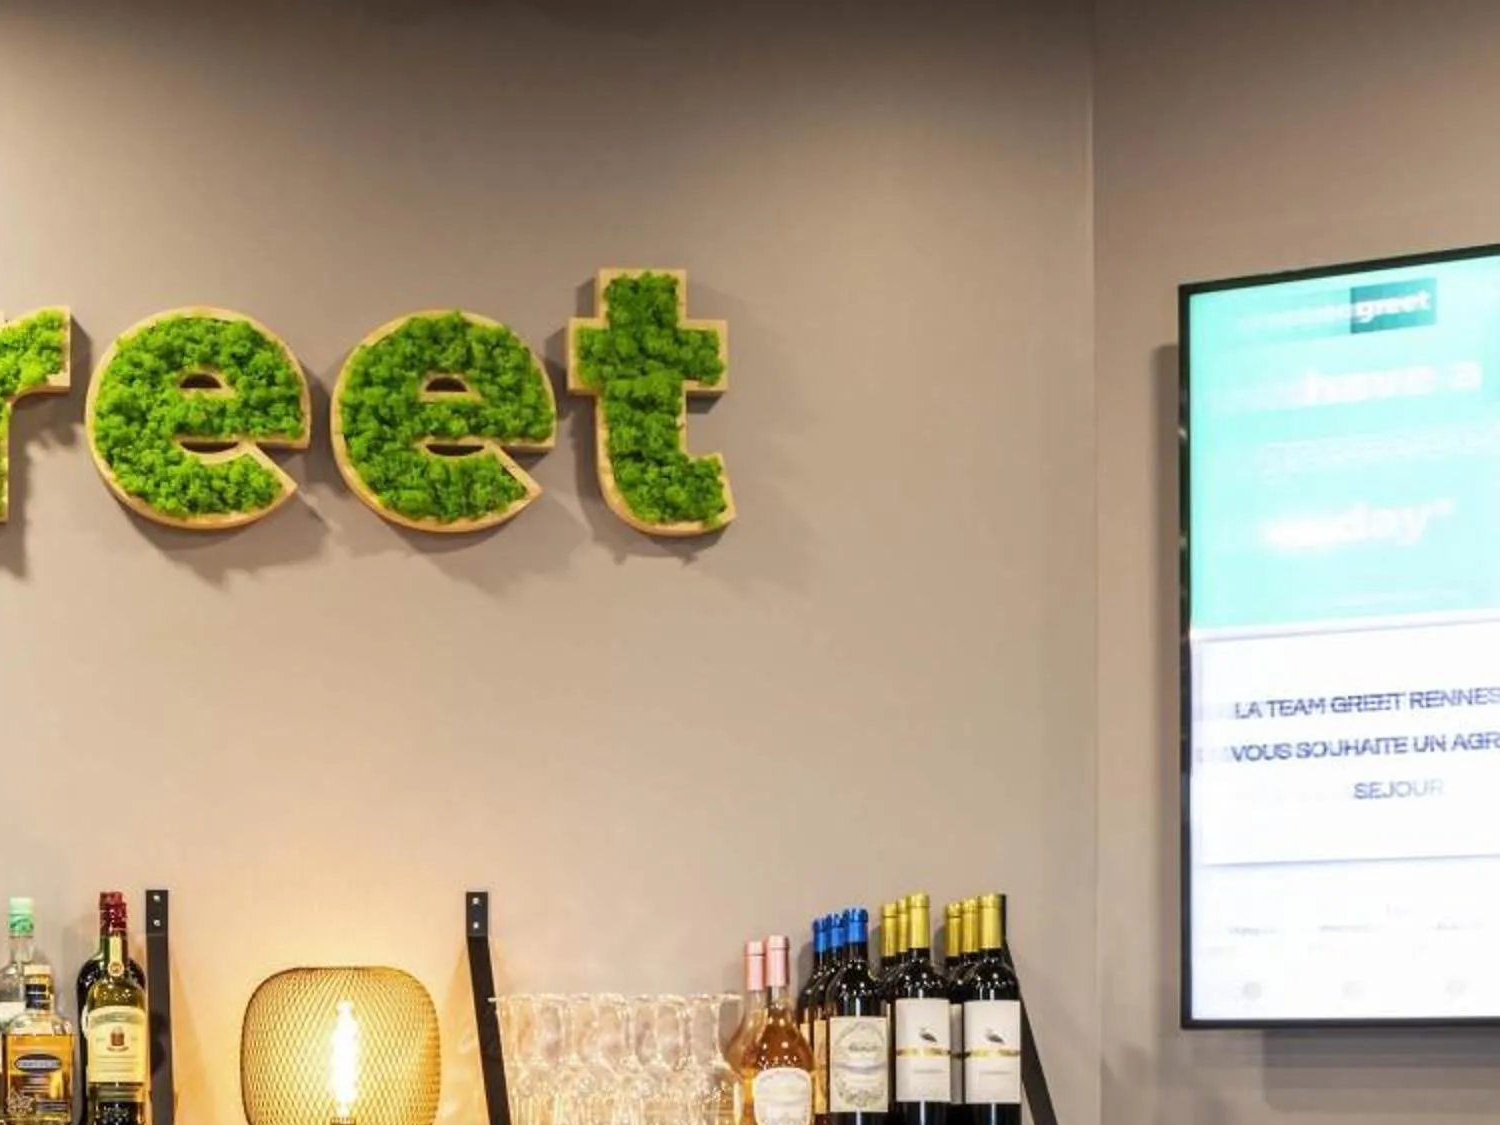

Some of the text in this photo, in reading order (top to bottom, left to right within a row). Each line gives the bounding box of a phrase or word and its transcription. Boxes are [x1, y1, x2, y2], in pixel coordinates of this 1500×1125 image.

[1353, 288, 1431, 323] greet
[1234, 702, 1262, 720] LA
[1267, 697, 1326, 718] TEAM
[1331, 692, 1405, 714] GREET
[1231, 742, 1292, 763] VOUS
[1296, 736, 1408, 761] SOUHAITE
[1413, 734, 1447, 754] UN
